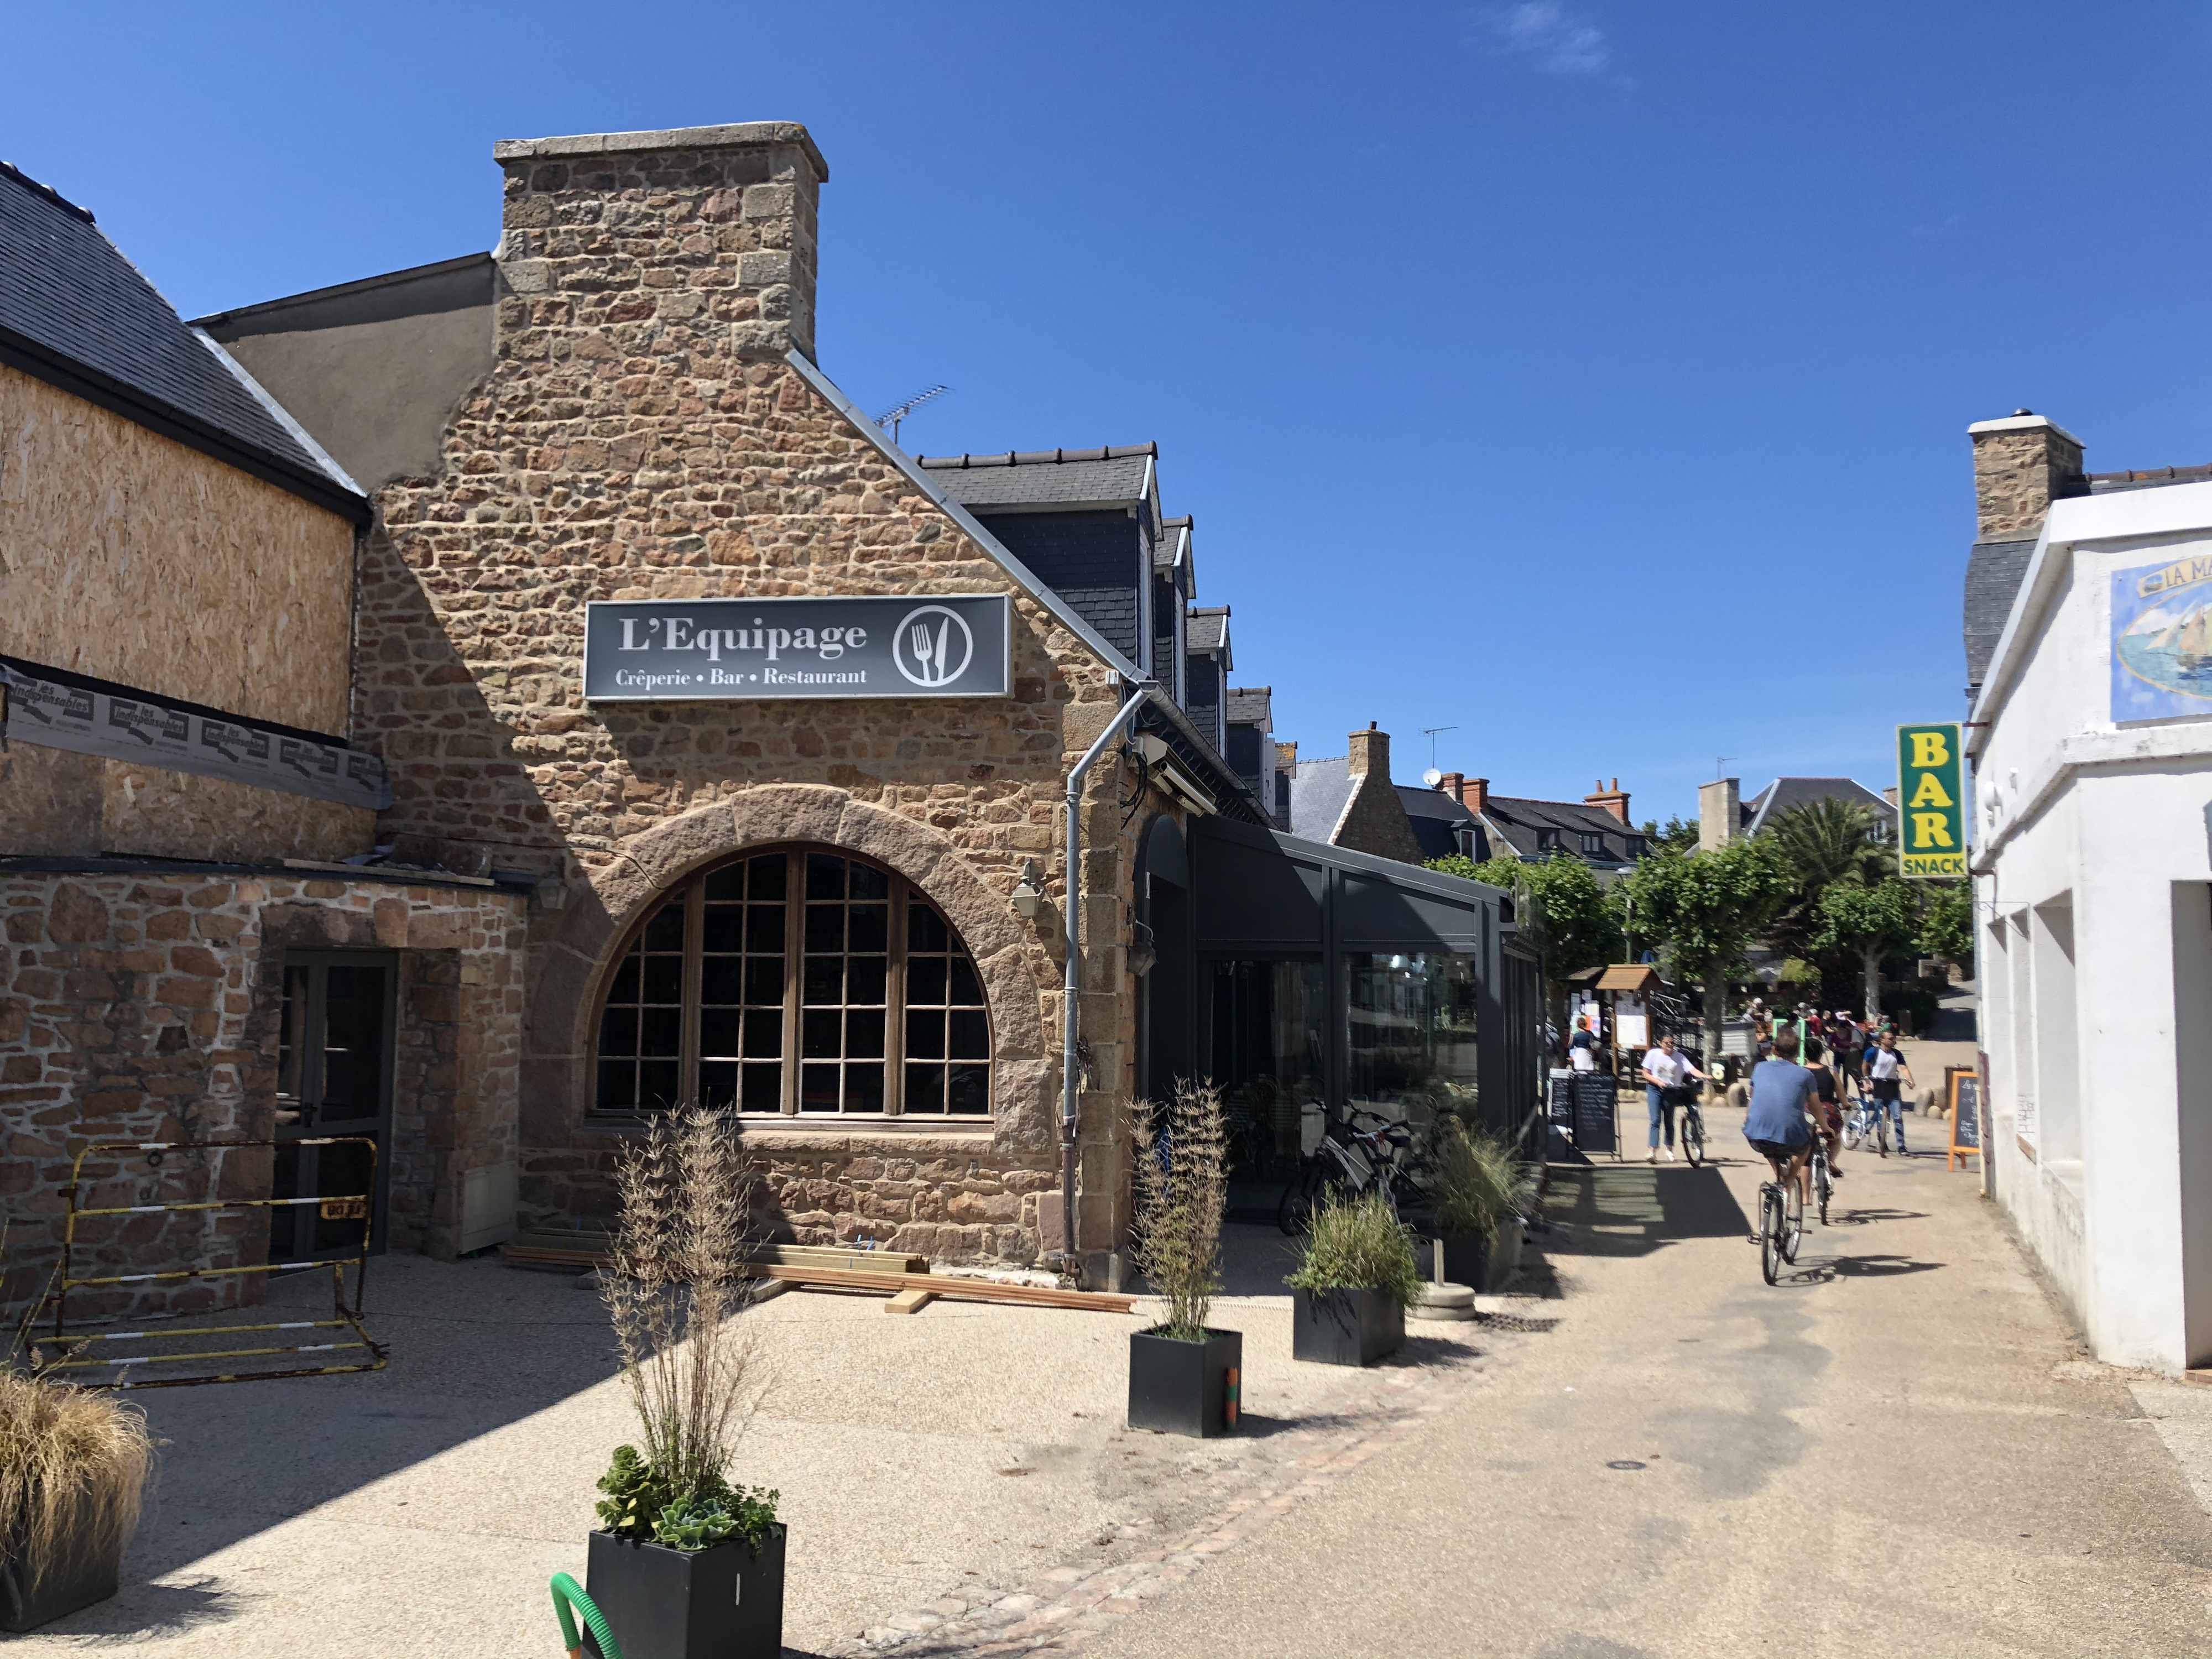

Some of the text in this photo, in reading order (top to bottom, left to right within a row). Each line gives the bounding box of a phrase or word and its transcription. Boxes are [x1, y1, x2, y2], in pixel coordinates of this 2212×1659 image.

[2165, 566, 2186, 587] LA
[39, 682, 55, 695] les
[615, 667, 867, 691] Crêperie Bar Restaurant
[1909, 732, 1954, 848] BAR
[1903, 858, 1964, 874] SNACK
